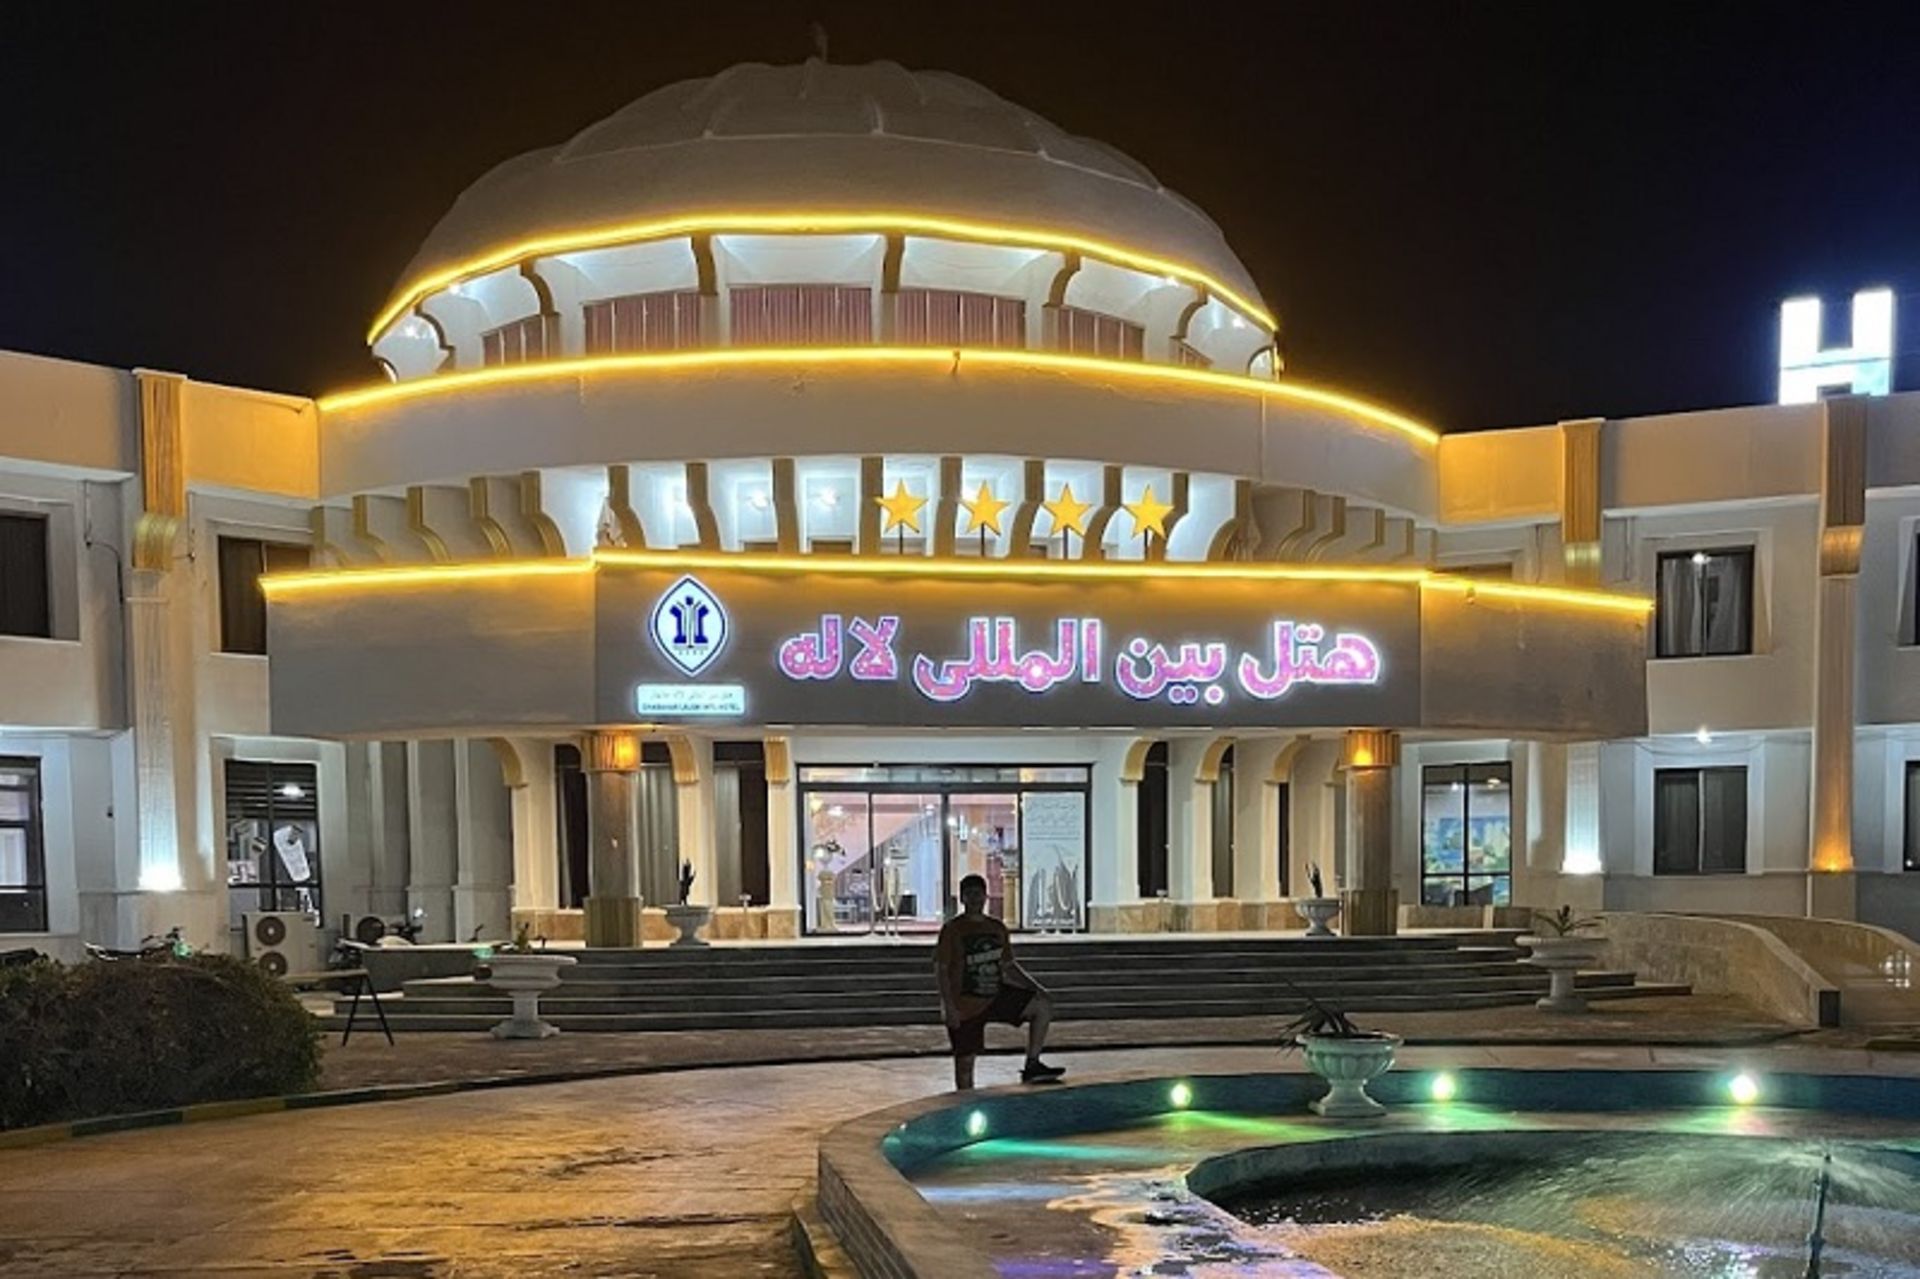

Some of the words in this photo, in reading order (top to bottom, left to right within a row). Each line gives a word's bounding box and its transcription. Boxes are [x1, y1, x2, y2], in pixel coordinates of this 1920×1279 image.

[1779, 288, 1892, 405] H
[779, 614, 899, 680] لاله
[914, 617, 1100, 701] المللی
[1116, 638, 1226, 704] بین
[1239, 621, 1380, 699] هتل
